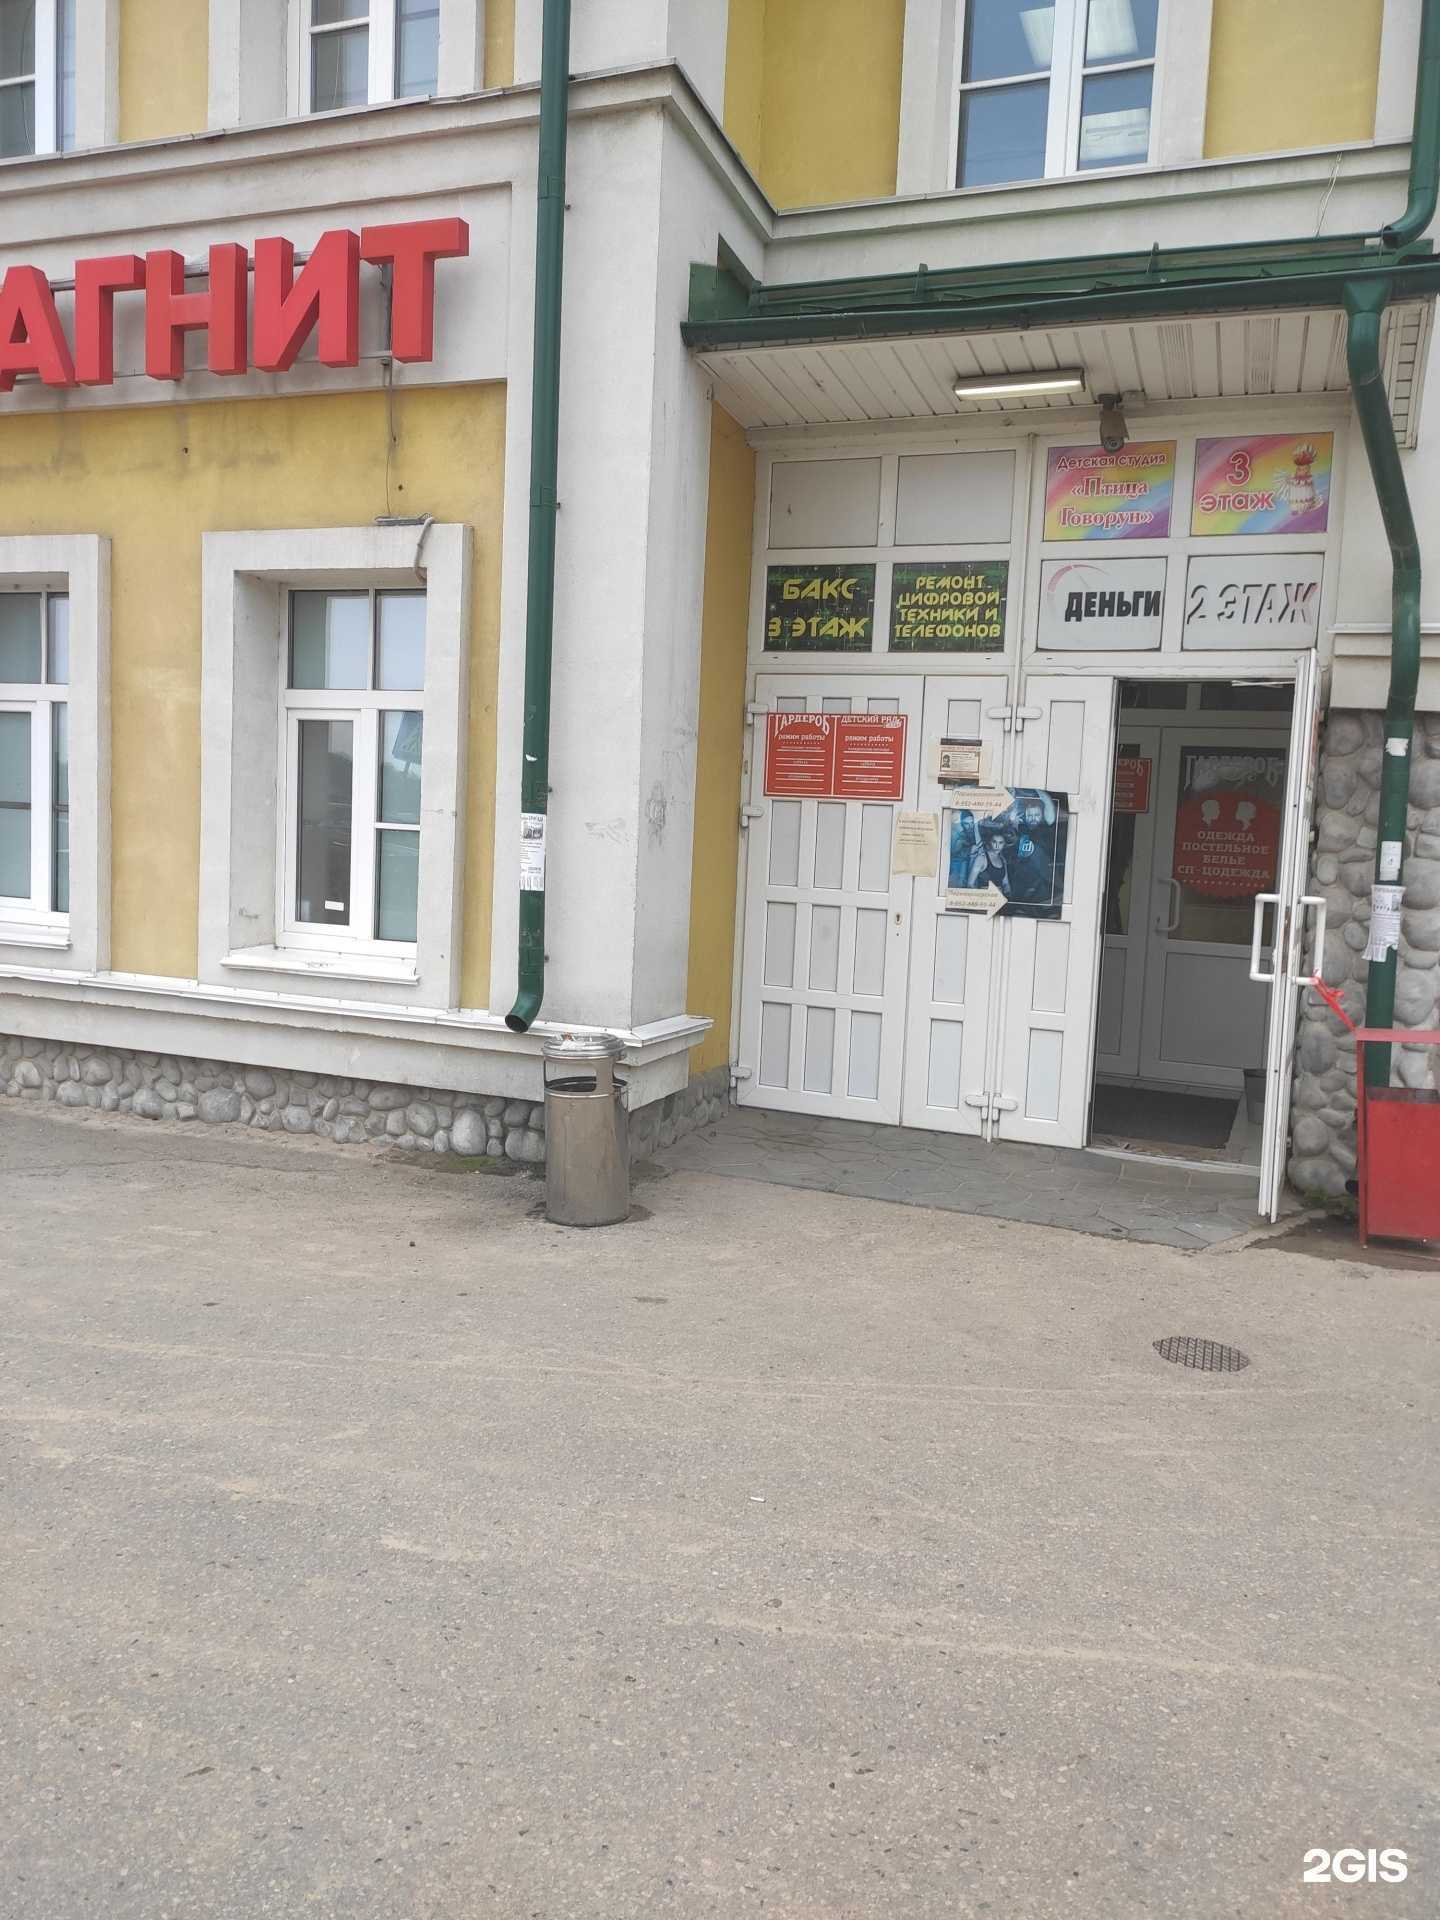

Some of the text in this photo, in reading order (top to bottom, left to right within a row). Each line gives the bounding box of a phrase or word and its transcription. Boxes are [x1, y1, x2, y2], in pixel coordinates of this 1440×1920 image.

[1057, 452, 1167, 470] Детская студия
[1227, 452, 1252, 486] 3
[1200, 491, 1275, 512] этаж
[1060, 506, 1154, 529] Говорун»
[783, 577, 859, 600] БАКС
[916, 576, 985, 590] РЕМОНТ
[1064, 590, 1162, 622] ДЕНЬГИ
[1187, 582, 1318, 624] 2 ЭТАЖ
[899, 607, 998, 622] ТЕХНИКИ И
[768, 617, 870, 638] 3 ЭТАЖ
[895, 623, 1001, 638] ТЕЛЕФОНОВ
[774, 714, 830, 738] ГАРДЕРОБ
[1197, 831, 1255, 843] ОДЕЖДА
[1182, 842, 1270, 855] ПОСТЕЛЬНОЕ
[1203, 855, 1247, 865] БЕЛЬЕ
[1178, 865, 1271, 879] СПЦОДЕЖДА
